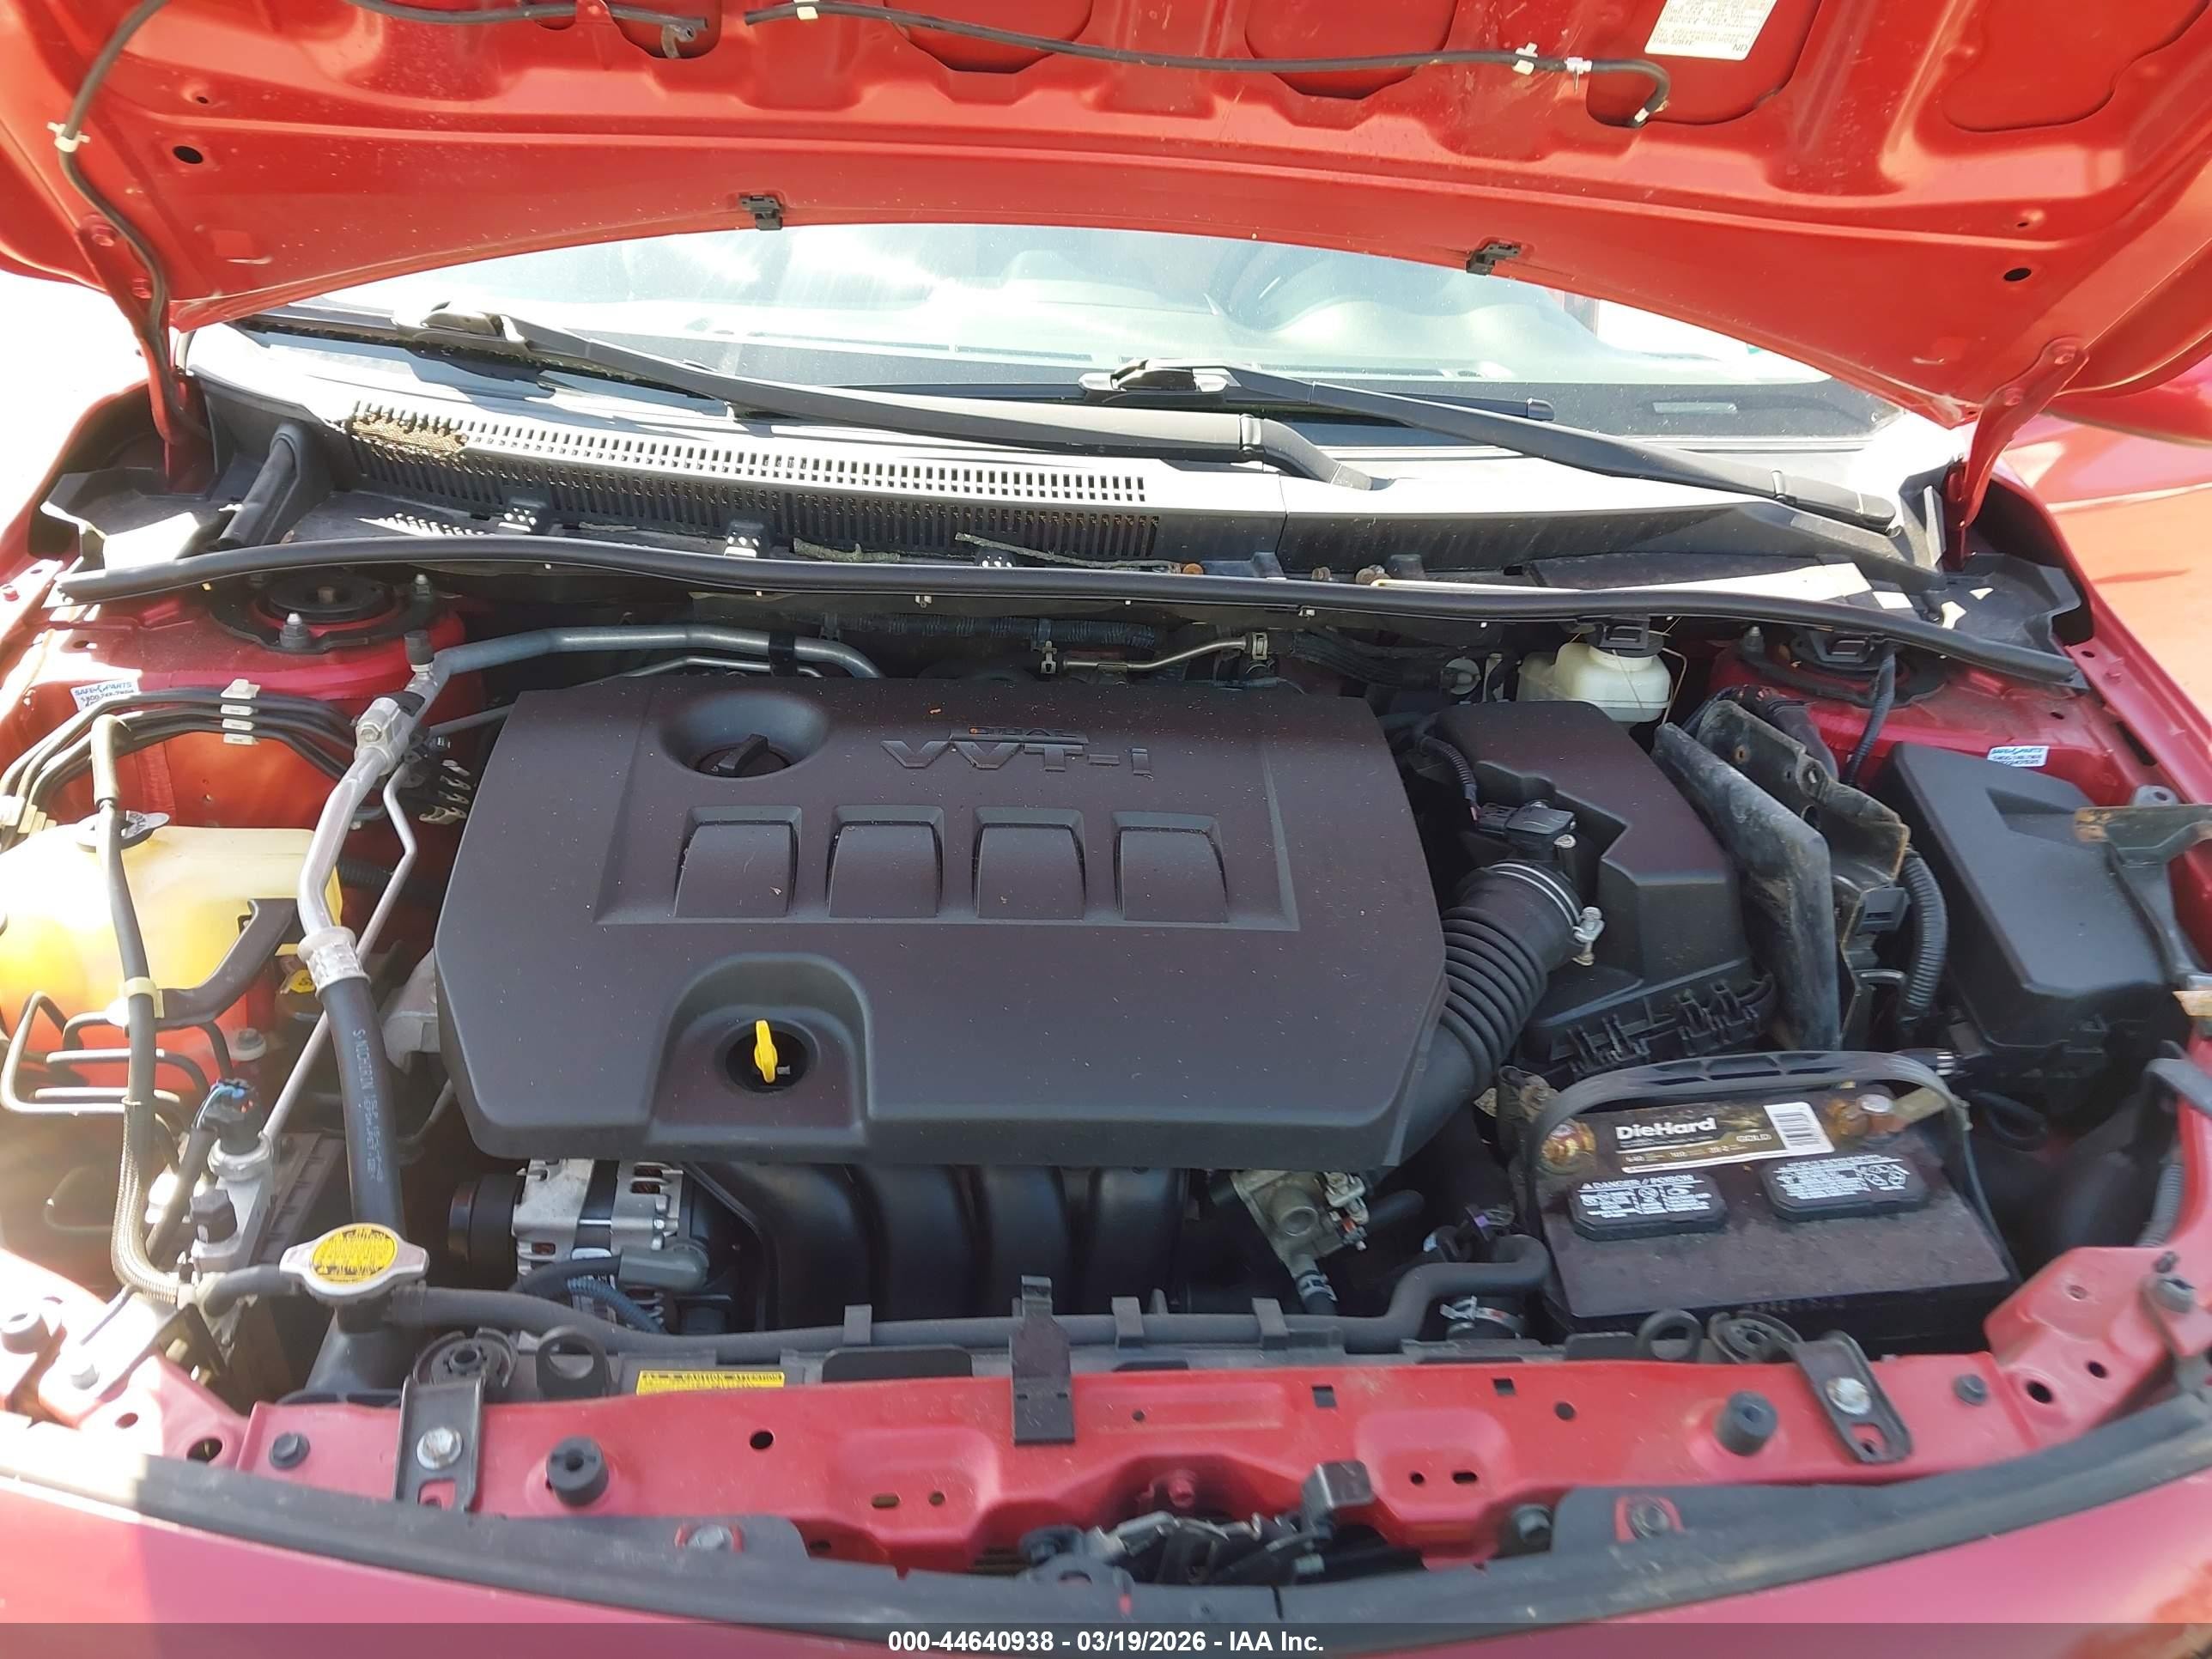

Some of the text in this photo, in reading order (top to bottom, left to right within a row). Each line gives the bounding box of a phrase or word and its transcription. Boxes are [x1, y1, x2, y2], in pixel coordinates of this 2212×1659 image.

[1614, 1117, 1717, 1140] DieHard
[1735, 1133, 1772, 1144] GOLD
[1650, 1174, 1695, 1185] POISON
